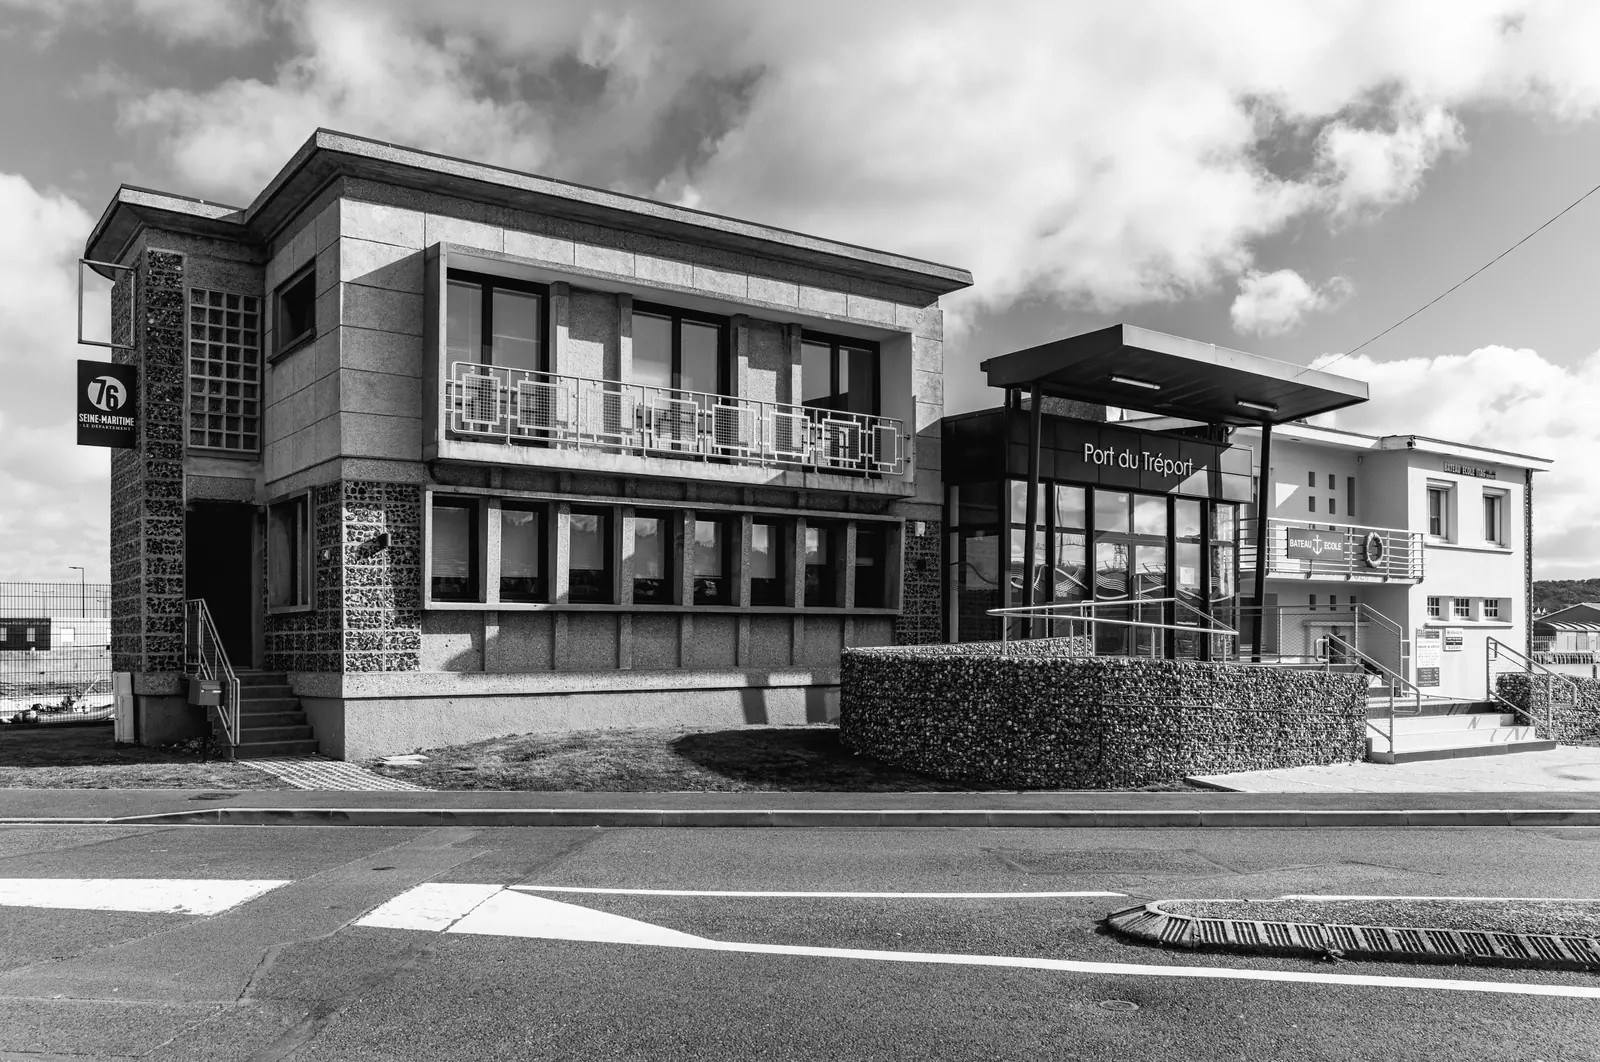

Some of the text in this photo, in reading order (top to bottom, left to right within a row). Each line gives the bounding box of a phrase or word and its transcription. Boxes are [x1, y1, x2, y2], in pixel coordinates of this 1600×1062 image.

[90, 379, 119, 411] 76
[79, 413, 134, 426] SEINE-MARITIME
[1084, 443, 1193, 478] Port du Tréport
[1444, 462, 1461, 474] BATEAU
[1290, 539, 1342, 551] BATEAU ECOLE
